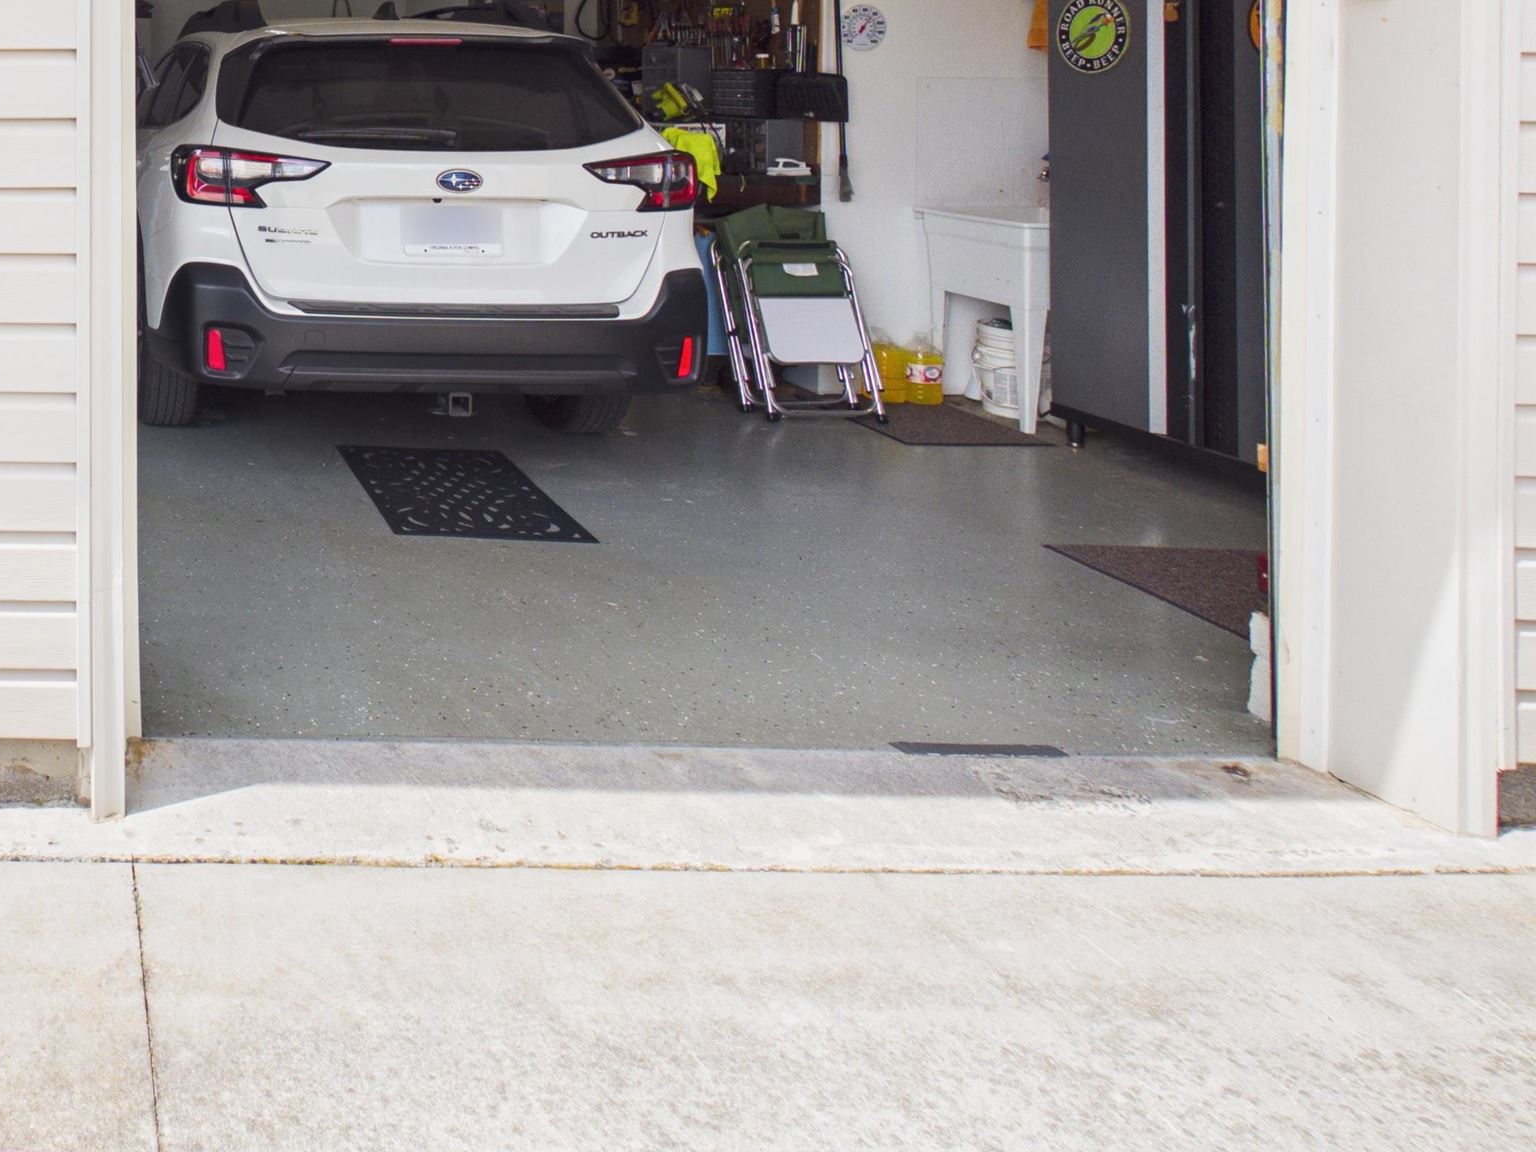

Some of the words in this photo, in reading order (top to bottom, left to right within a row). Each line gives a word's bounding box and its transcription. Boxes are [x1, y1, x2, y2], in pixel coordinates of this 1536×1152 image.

[1061, 0, 1085, 31] ROAD
[1062, 41, 1086, 67] BEEP
[1093, 44, 1120, 69] BEEP
[590, 229, 648, 239] OUTBACK
